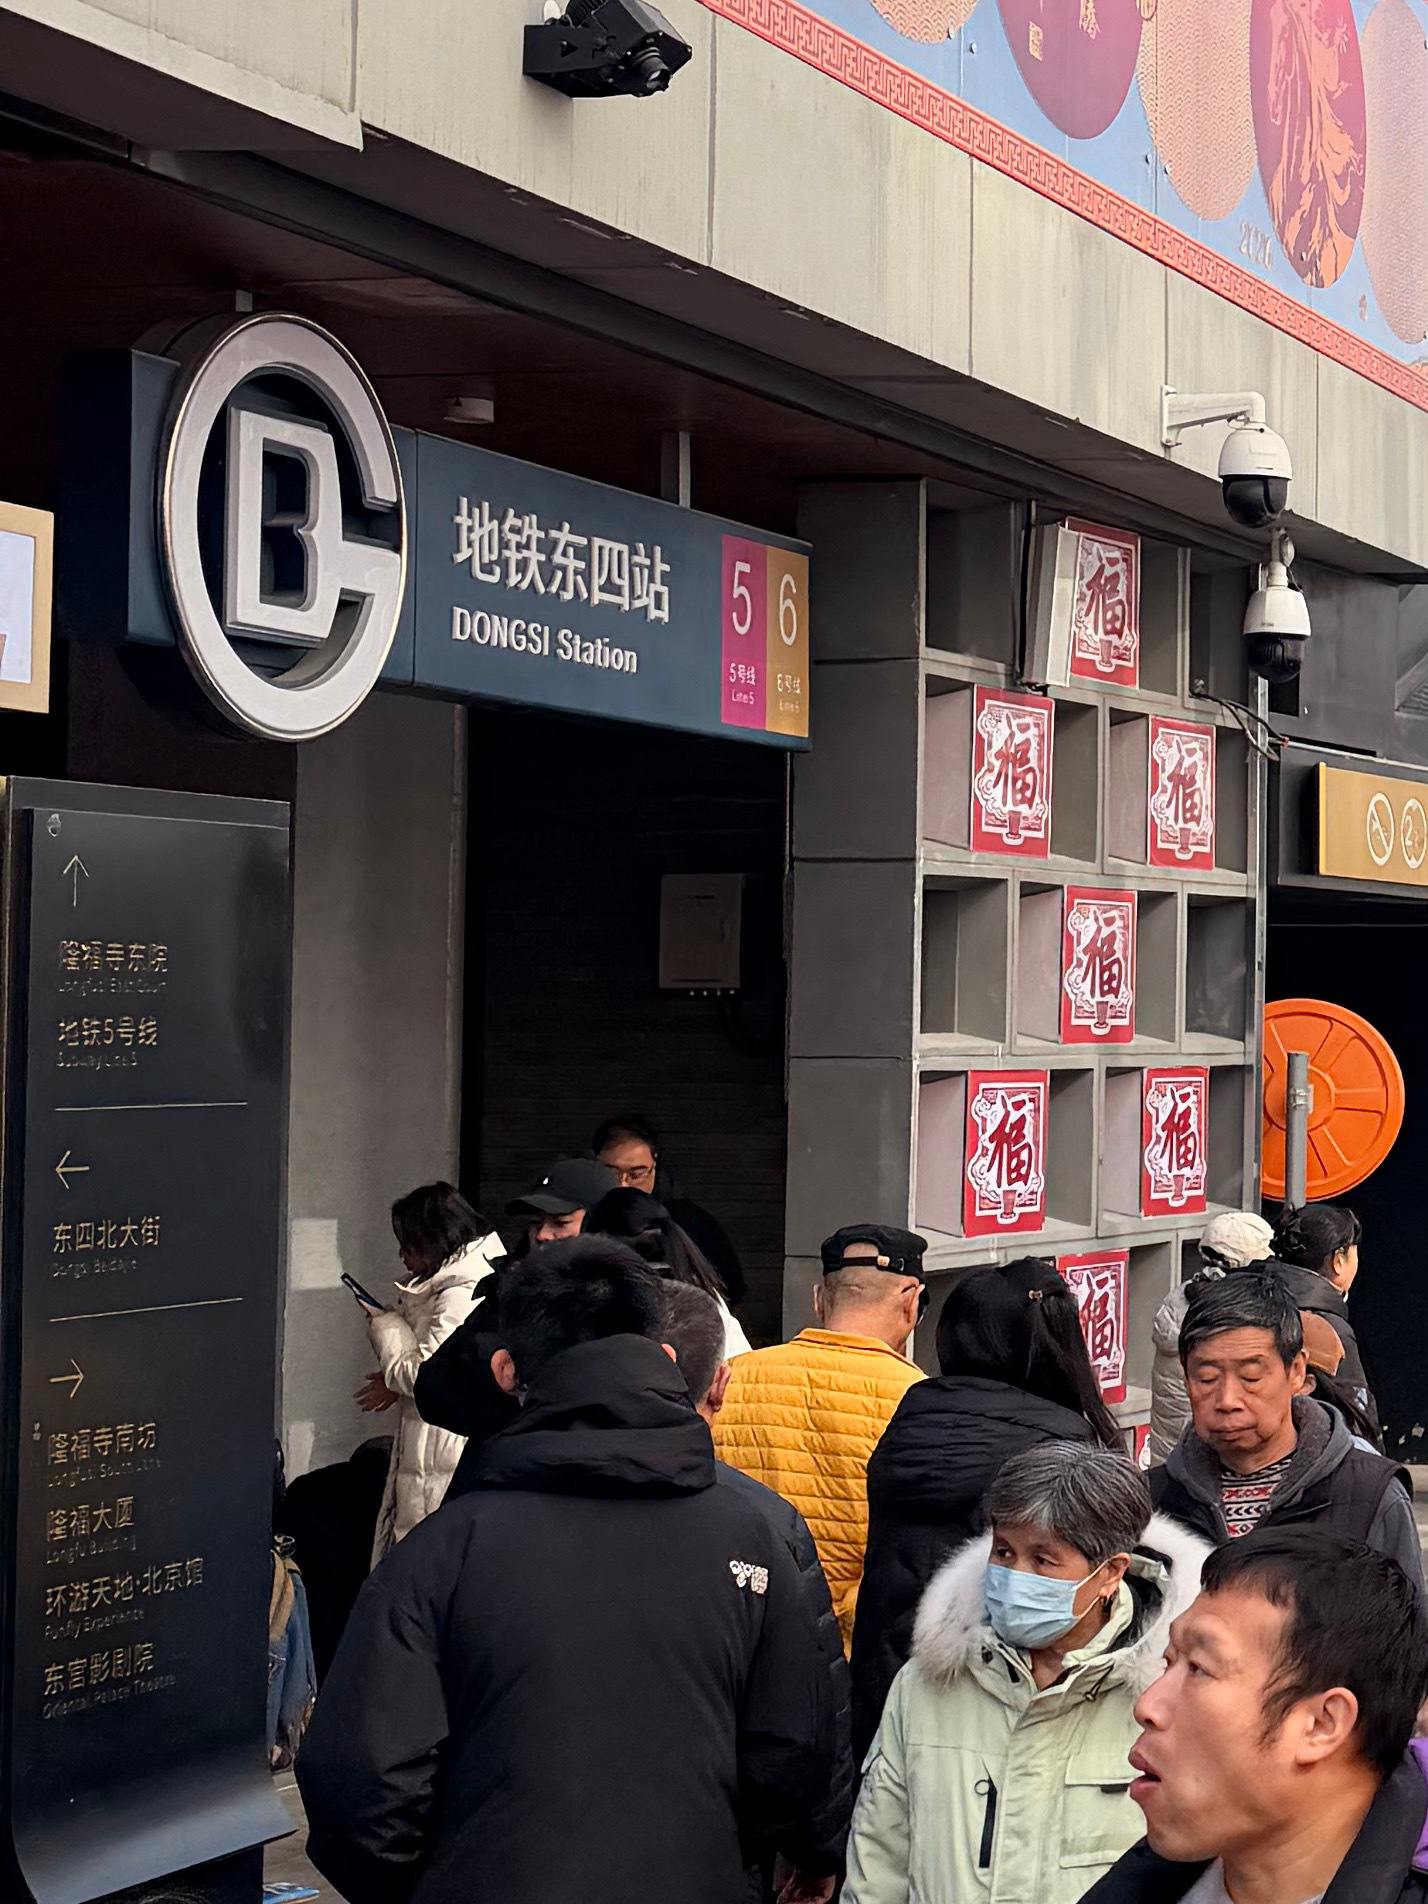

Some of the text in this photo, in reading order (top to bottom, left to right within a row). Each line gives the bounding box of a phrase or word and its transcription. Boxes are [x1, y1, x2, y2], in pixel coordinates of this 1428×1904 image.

[1240, 221, 1272, 271] 2026
[452, 495, 671, 626] 地铁东四站
[1084, 549, 1125, 640] 福
[732, 560, 752, 636] 5
[778, 573, 797, 646] 6
[451, 605, 639, 674] DONGSI Station
[991, 718, 1037, 811] 福
[1164, 744, 1203, 831] 福
[59, 940, 169, 972] 隆福寺东院
[1081, 909, 1124, 1000] 福
[57, 1016, 158, 1046] 地铁5号线
[986, 1095, 1034, 1191] 福
[1158, 1088, 1201, 1174] 福
[52, 1215, 161, 1254] 东四北大街
[47, 1422, 157, 1466] 隆福寺南坊
[46, 1495, 135, 1542] 隆福大厦
[83, 1608, 145, 1633] Experience
[43, 1642, 155, 1696] 东宫影剧院
[94, 1685, 130, 1704] Palace
